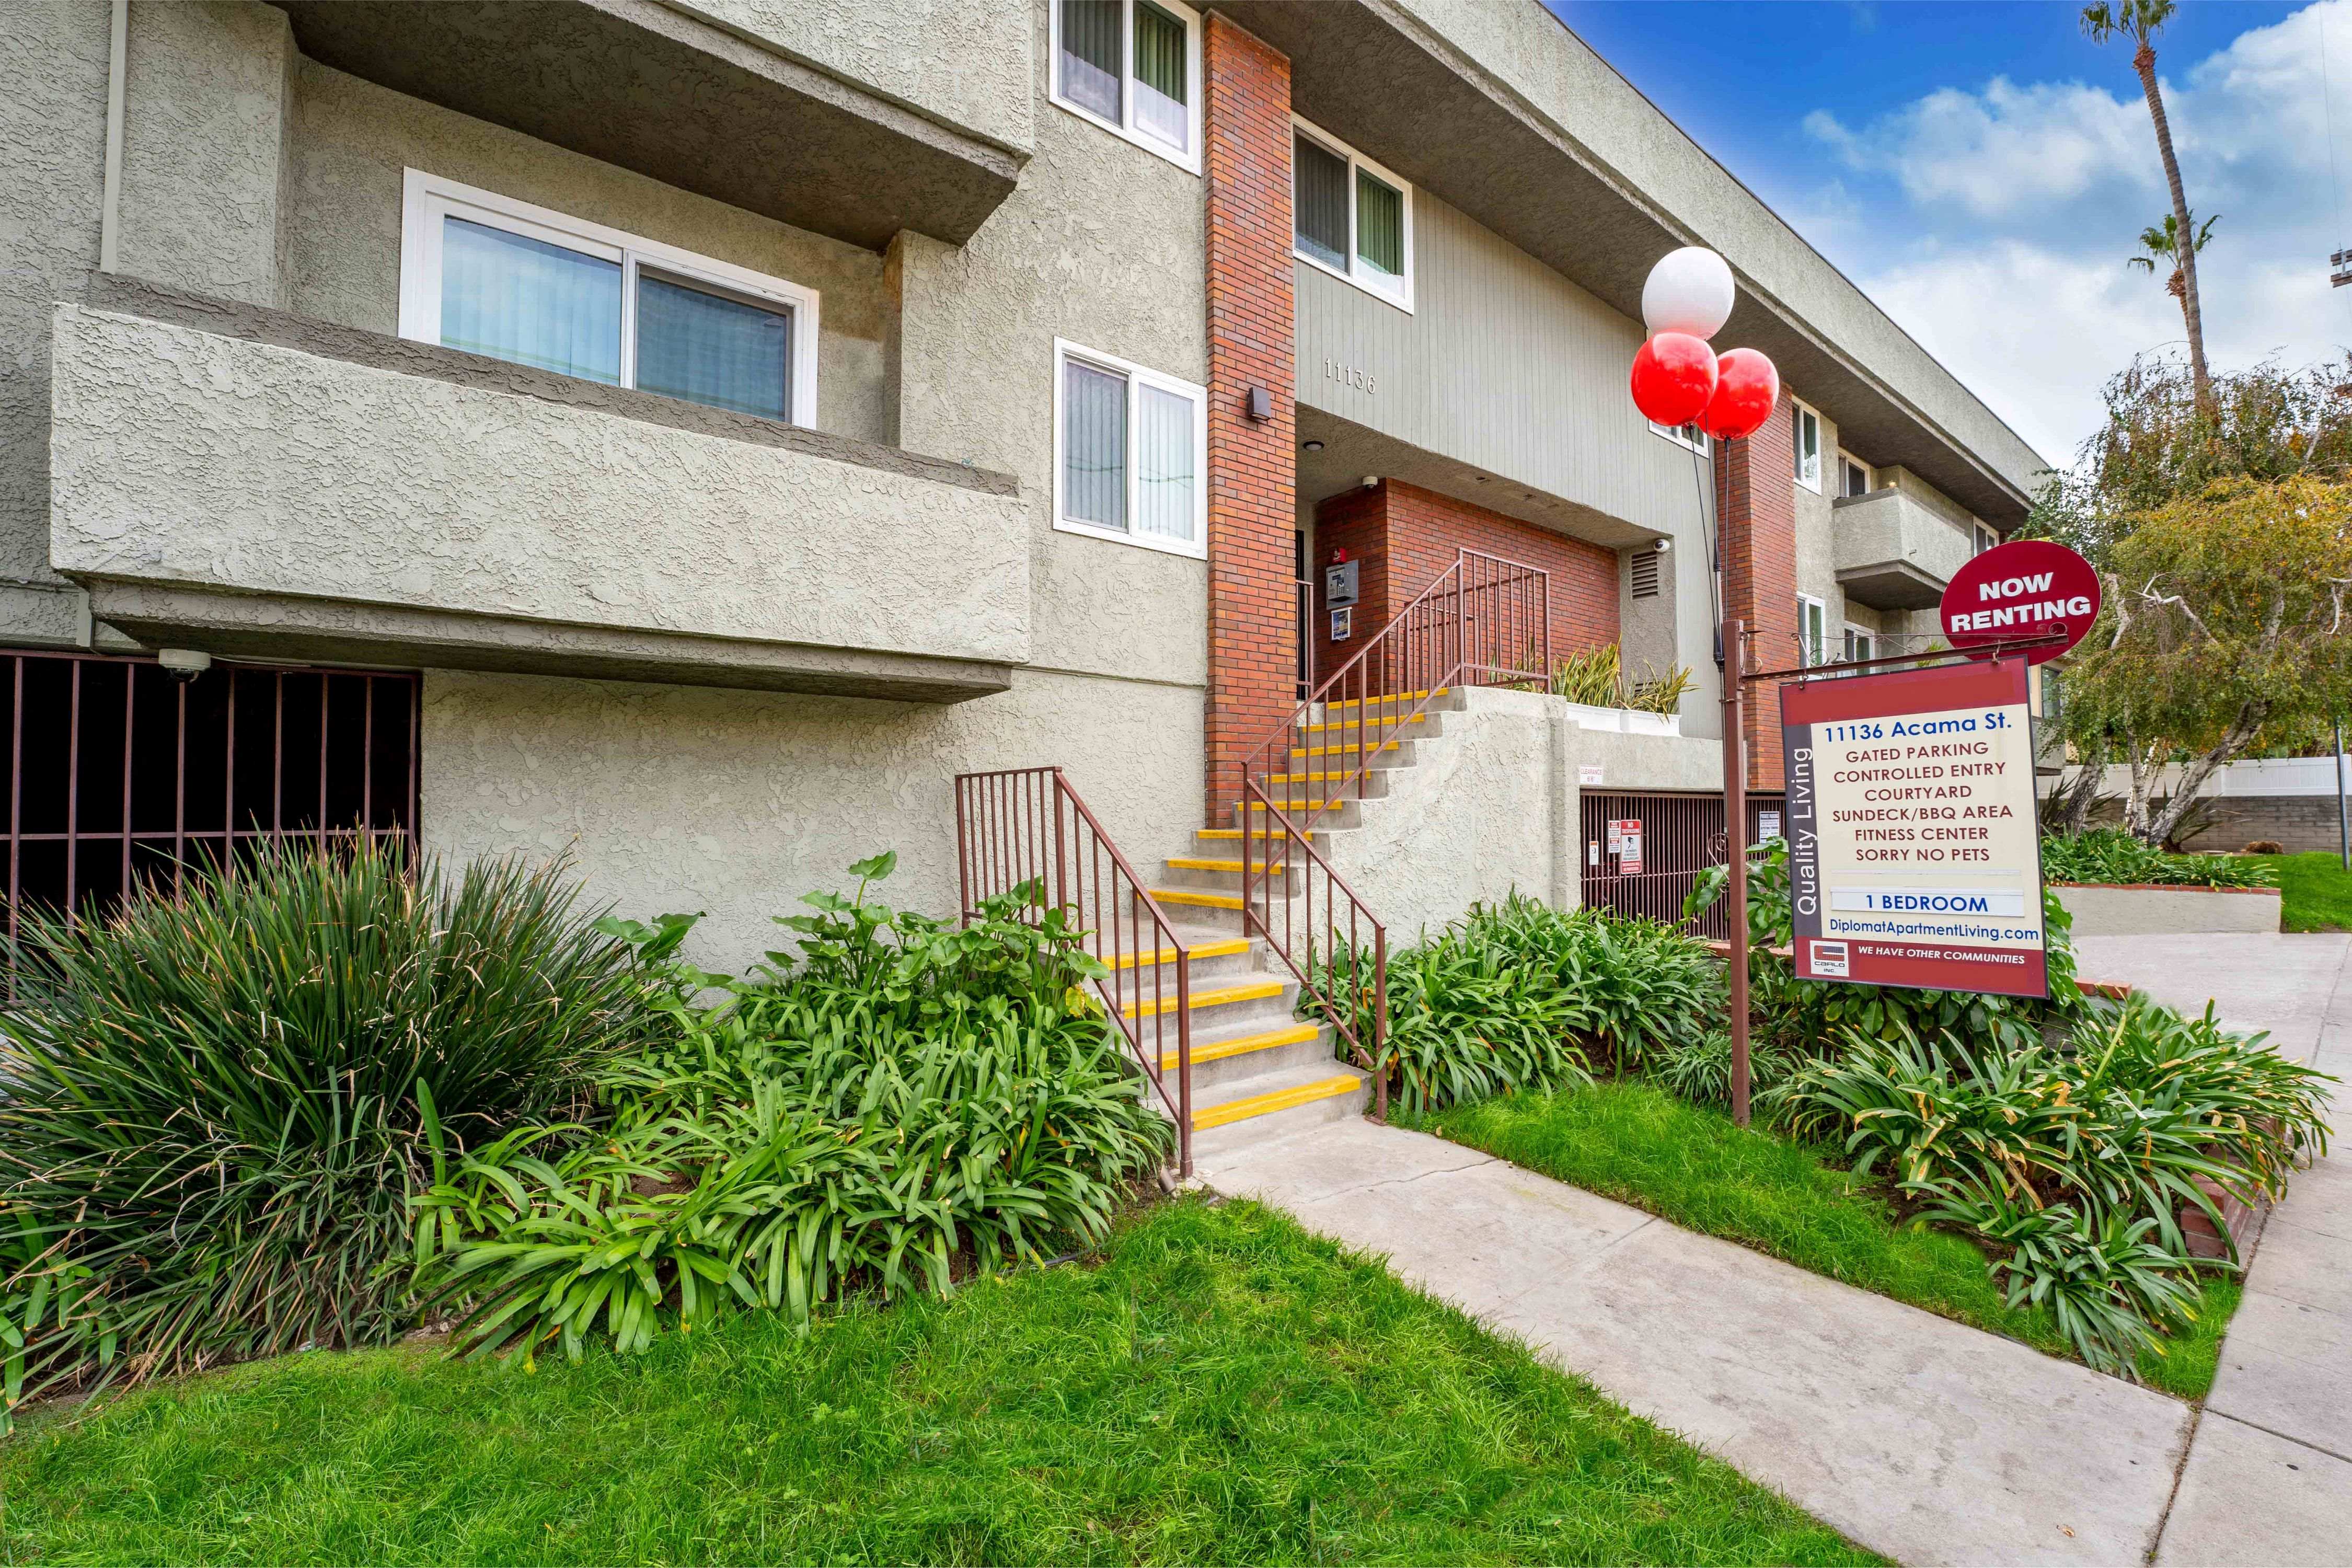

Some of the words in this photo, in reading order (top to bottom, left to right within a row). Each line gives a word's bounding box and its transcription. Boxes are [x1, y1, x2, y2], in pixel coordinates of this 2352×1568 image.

[1325, 358, 1376, 394] 11136
[1979, 571, 2054, 601] NOW
[1951, 596, 2091, 632] RENTING
[1825, 724, 1883, 742] 11136
[1891, 719, 1976, 737] Acama
[1984, 712, 2012, 730] St.
[1846, 748, 1900, 763] GATED
[1907, 742, 1989, 759] PARKING
[1791, 748, 1813, 818] Living
[1834, 766, 1944, 783] CONTROLLED
[1951, 762, 2006, 777] ENTRY
[1864, 786, 1971, 801] COURTYARD
[1832, 806, 1956, 822] SUNDECK/BBQ
[1963, 805, 2013, 819] AREA
[1855, 829, 1915, 841] FITNESS
[1921, 827, 1989, 840] CENTER
[1855, 849, 1909, 861] SORRY
[1917, 849, 1945, 861] NO
[1952, 849, 1990, 861] PETS
[1795, 829, 1818, 915] Quality
[1866, 895, 1873, 908] 1
[1882, 895, 1989, 913] BEDROOM
[1830, 918, 2039, 941] DiplomatApartmentLiving.com
[1858, 946, 1873, 955] WE
[1875, 947, 1905, 957] HAVE
[1907, 948, 1941, 959] OTHER
[1943, 950, 2025, 965] COMMUNITIES
